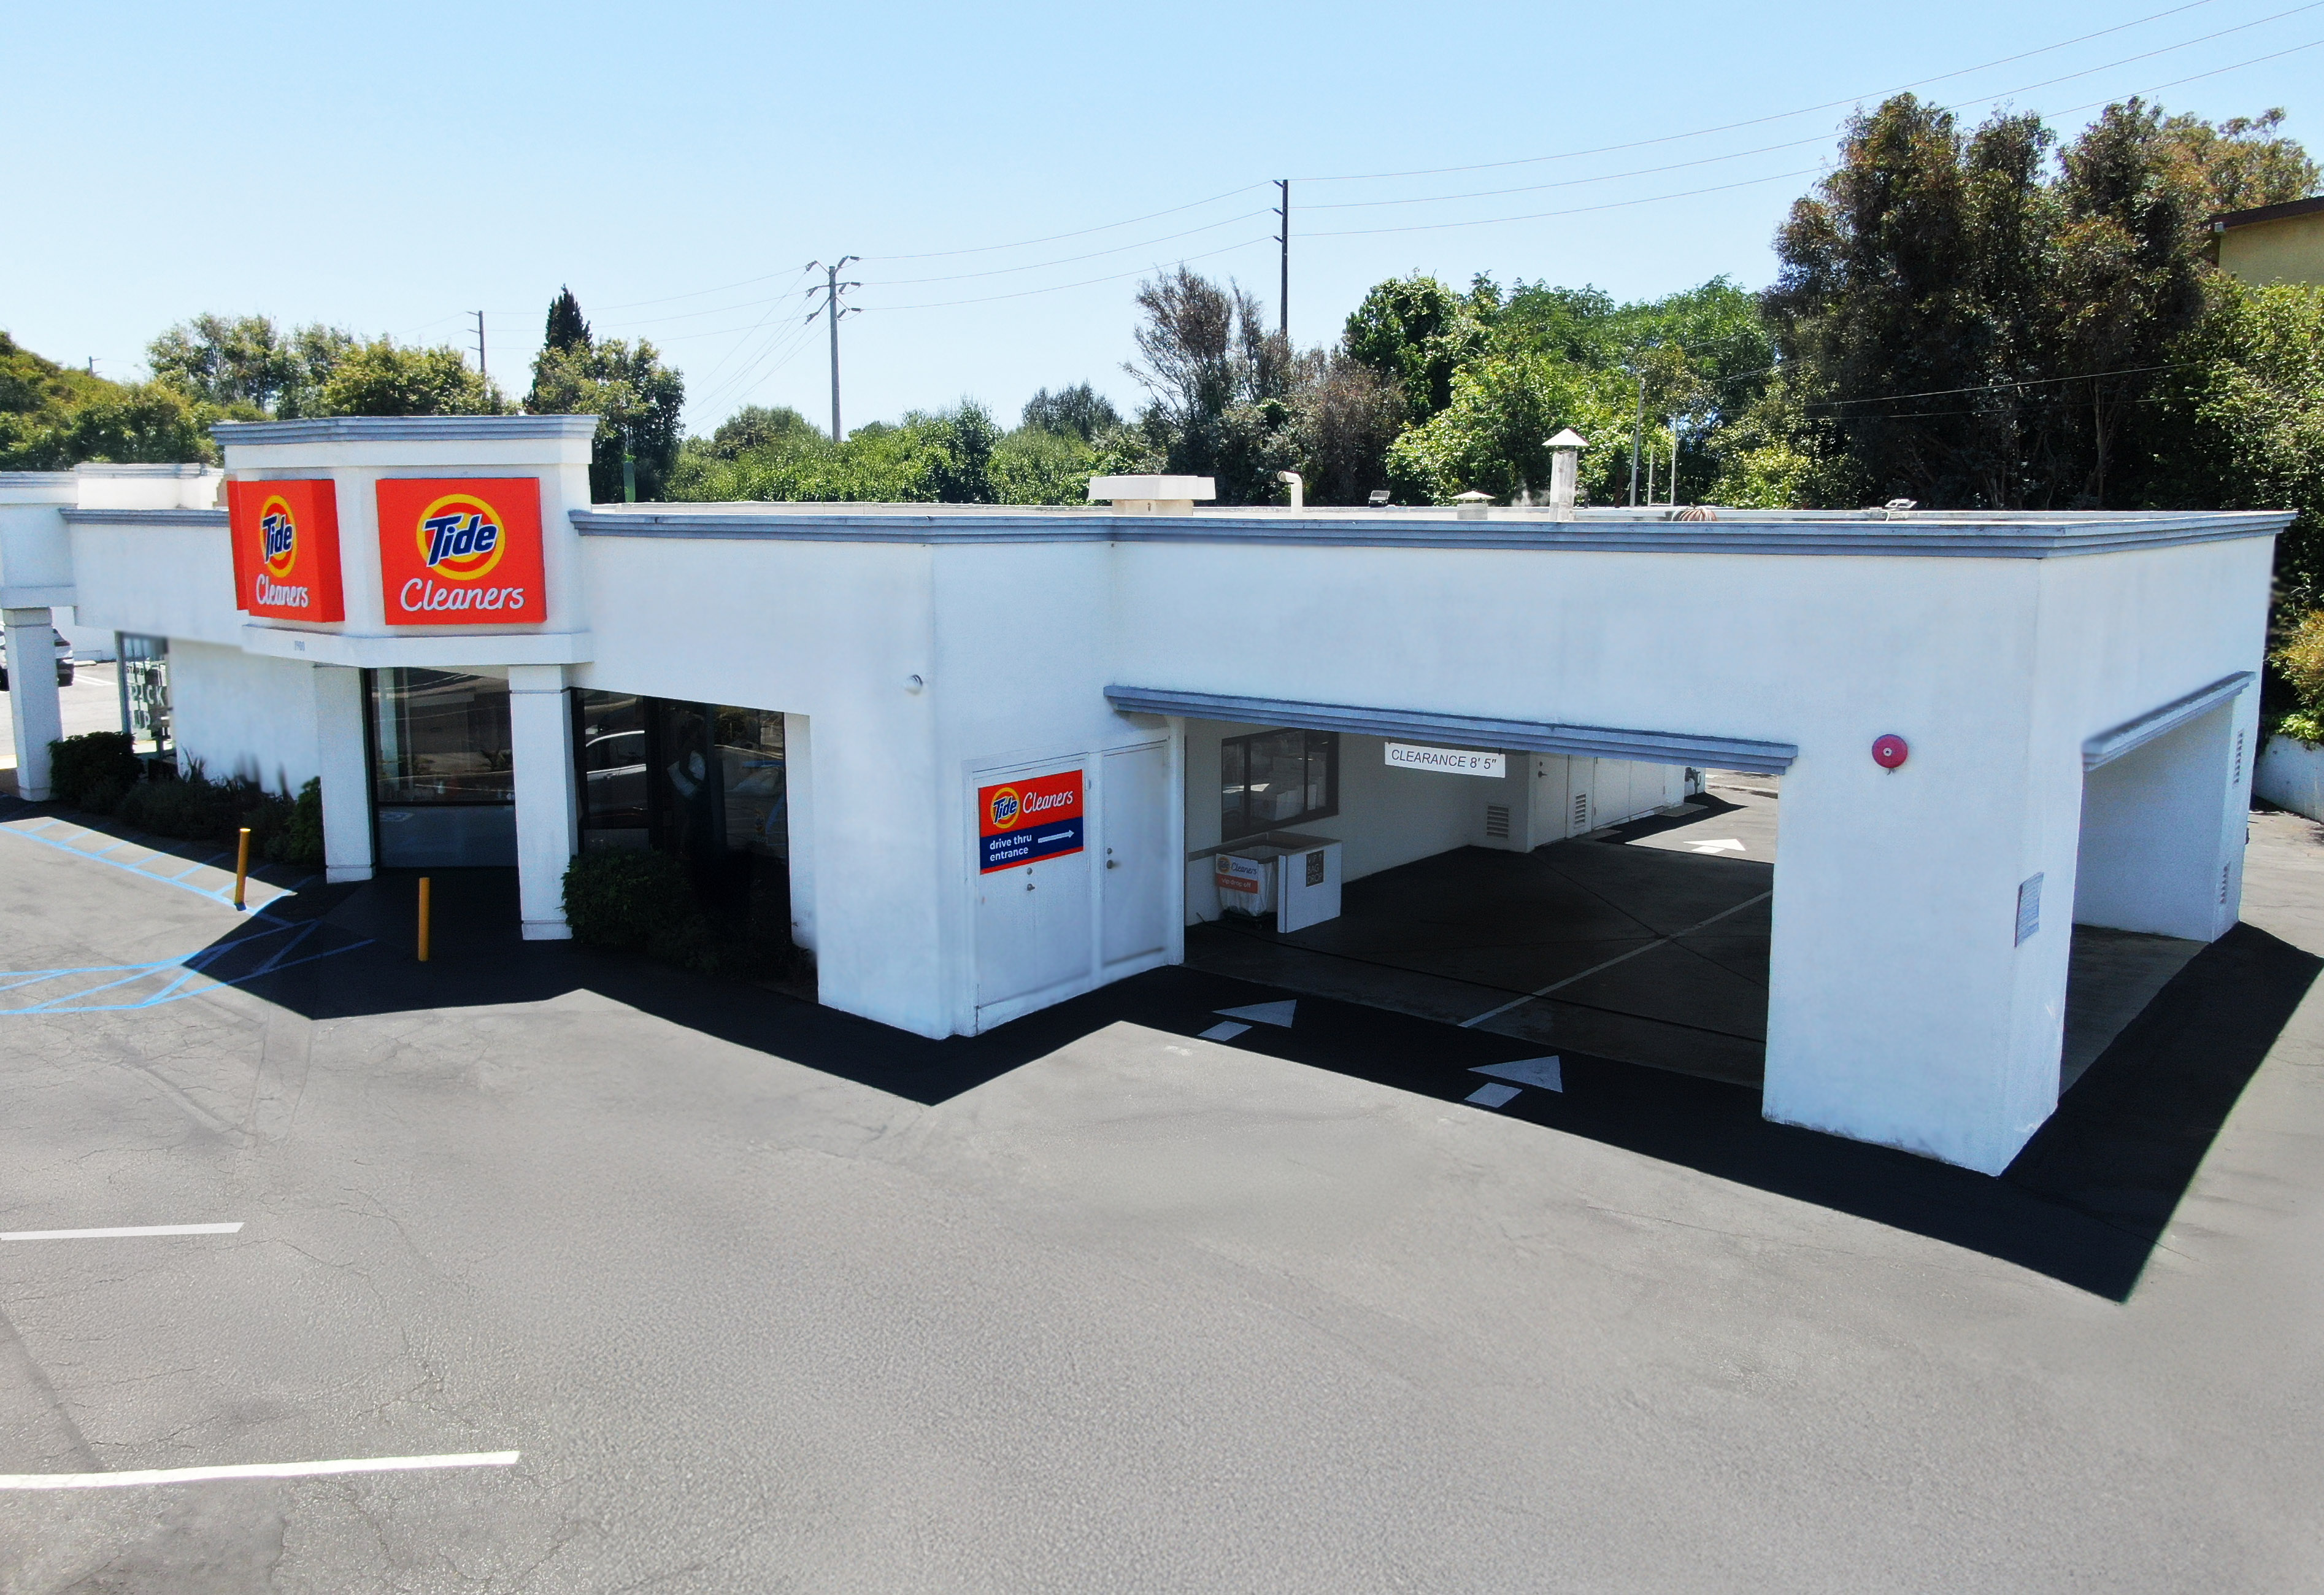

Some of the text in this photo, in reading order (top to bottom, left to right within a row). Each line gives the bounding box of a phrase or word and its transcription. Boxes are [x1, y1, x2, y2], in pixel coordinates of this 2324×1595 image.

[262, 514, 293, 564] Tide
[423, 514, 498, 567] Tide
[256, 574, 309, 608] Cleaners
[401, 577, 525, 611] Cleaners
[1391, 749, 1466, 767] CLEARANCE
[1470, 757, 1480, 768] 8'
[993, 790, 1073, 824] Tide Cleaners
[990, 833, 1032, 850] drive thru
[990, 846, 1029, 862] entrance
[1231, 862, 1257, 875] Cleaners
[1307, 863, 1319, 875] BAG
[1307, 872, 1323, 884] DROP
